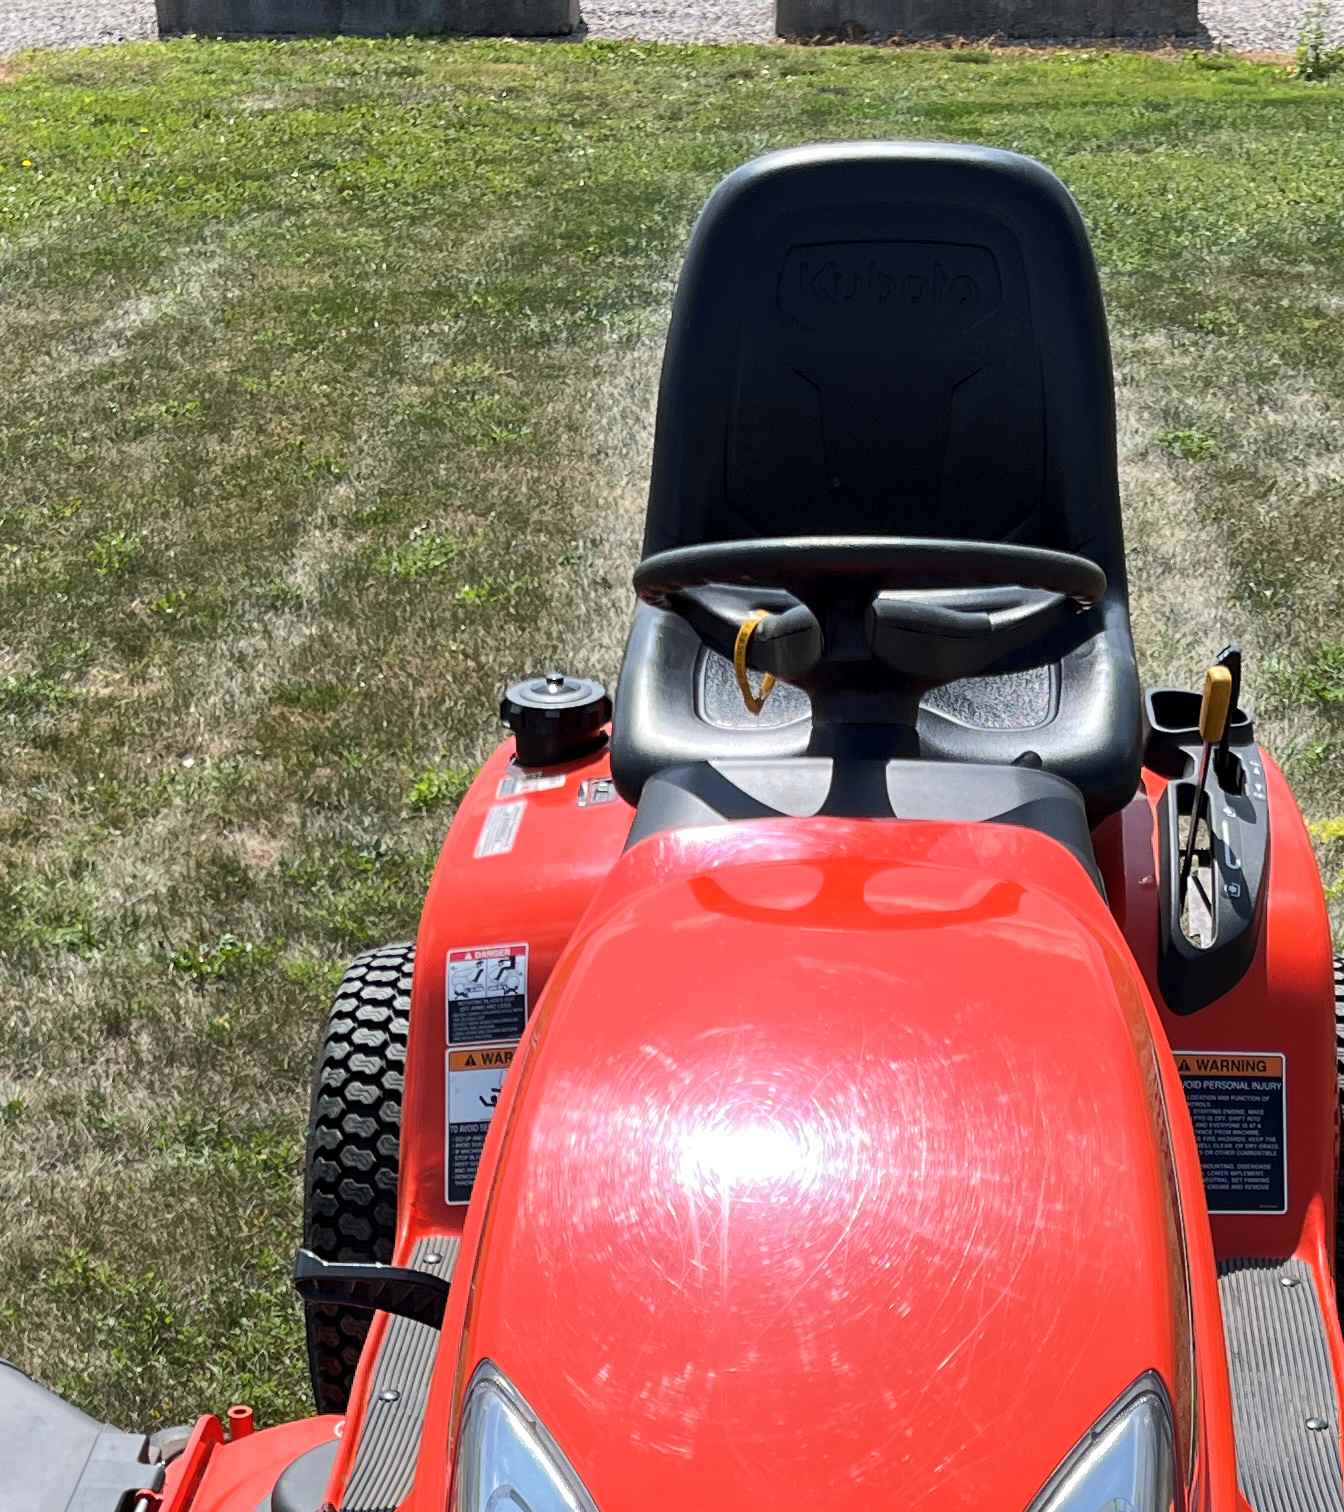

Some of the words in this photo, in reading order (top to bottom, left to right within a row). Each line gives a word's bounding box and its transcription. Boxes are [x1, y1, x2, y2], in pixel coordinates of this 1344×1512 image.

[799, 257, 978, 304] Kubota
[481, 1051, 515, 1065] WAR
[1197, 1060, 1267, 1073] WARNING
[1203, 1081, 1250, 1090] PERSONAL
[1252, 1081, 1282, 1091] INJURY
